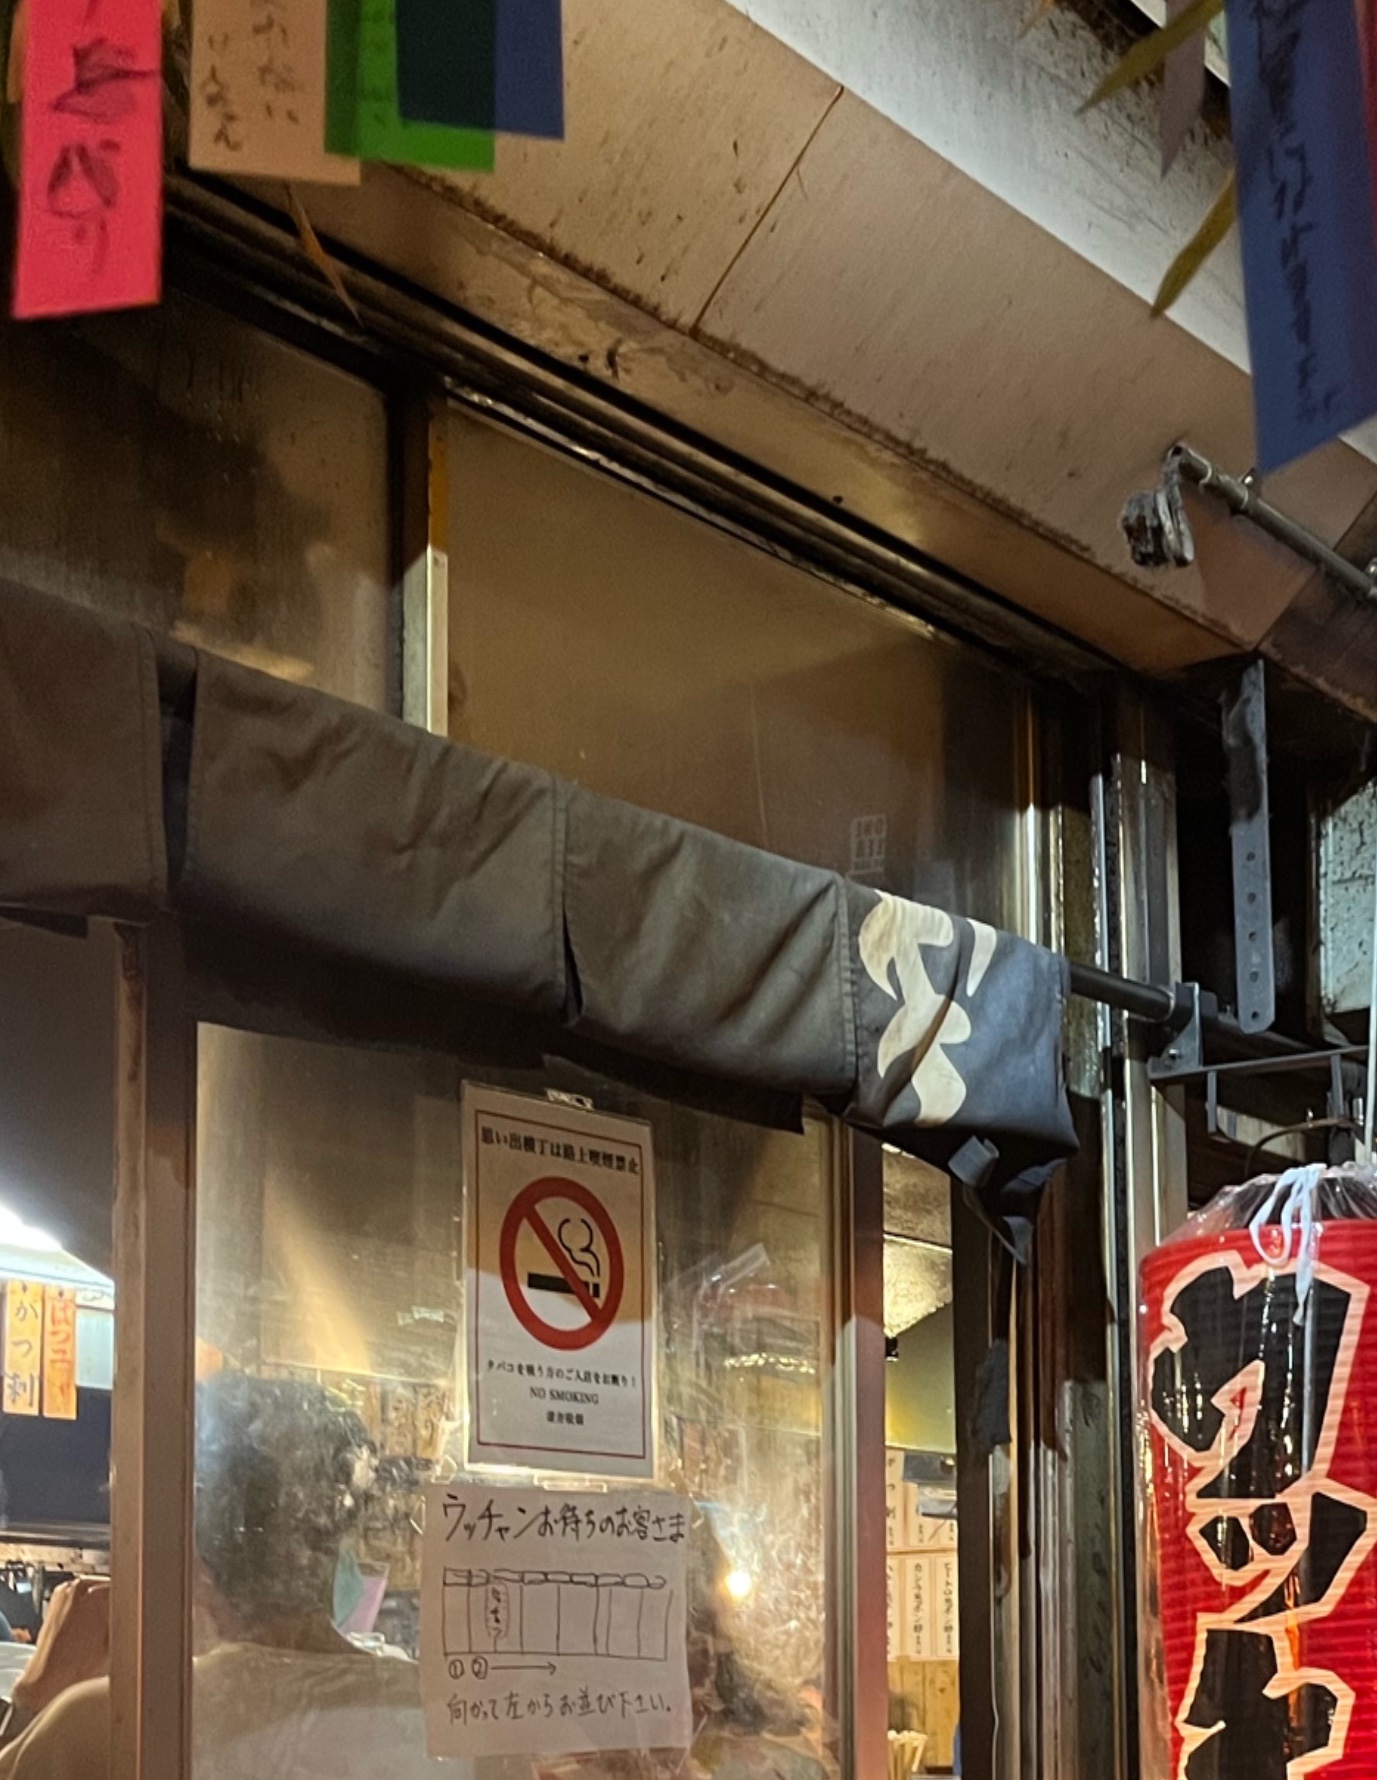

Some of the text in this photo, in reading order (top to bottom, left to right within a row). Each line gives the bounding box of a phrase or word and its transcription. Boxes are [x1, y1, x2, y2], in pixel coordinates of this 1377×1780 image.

[529, 1386, 600, 1405] NO SMOKING
[443, 1493, 685, 1543] ウッチャンお待ちのお客さま
